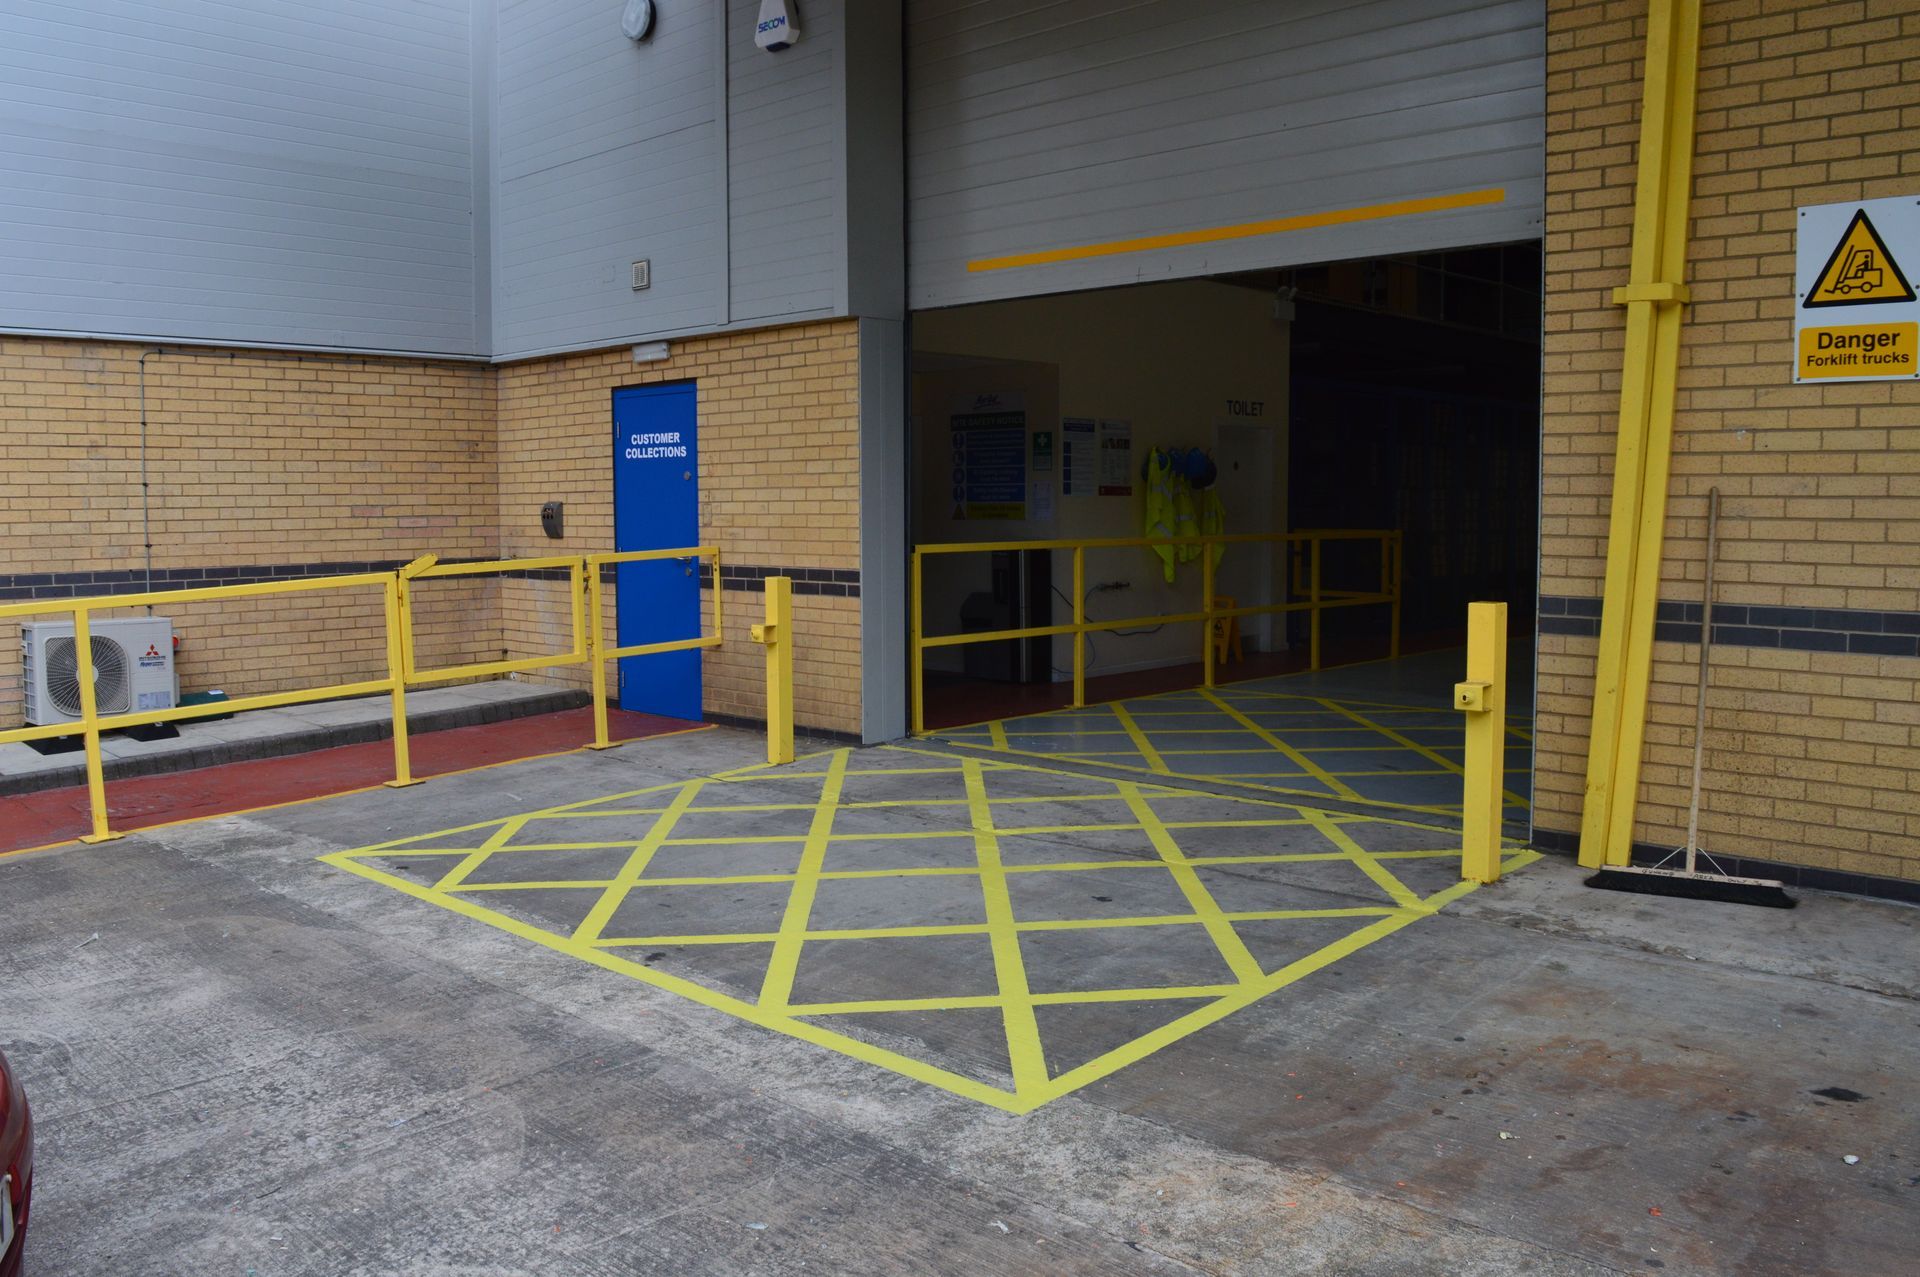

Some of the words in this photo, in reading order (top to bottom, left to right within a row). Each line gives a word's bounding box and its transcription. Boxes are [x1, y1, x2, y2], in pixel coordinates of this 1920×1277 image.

[758, 15, 786, 33] SECOM
[1817, 332, 1901, 352] Danger
[1807, 353, 1858, 367] Forklift
[1862, 352, 1910, 364] trucks
[1226, 399, 1265, 416] TOILET
[997, 415, 1025, 425] NOTICE
[631, 432, 680, 445] CUSTOMER
[625, 446, 687, 459] COLLECTIONS
